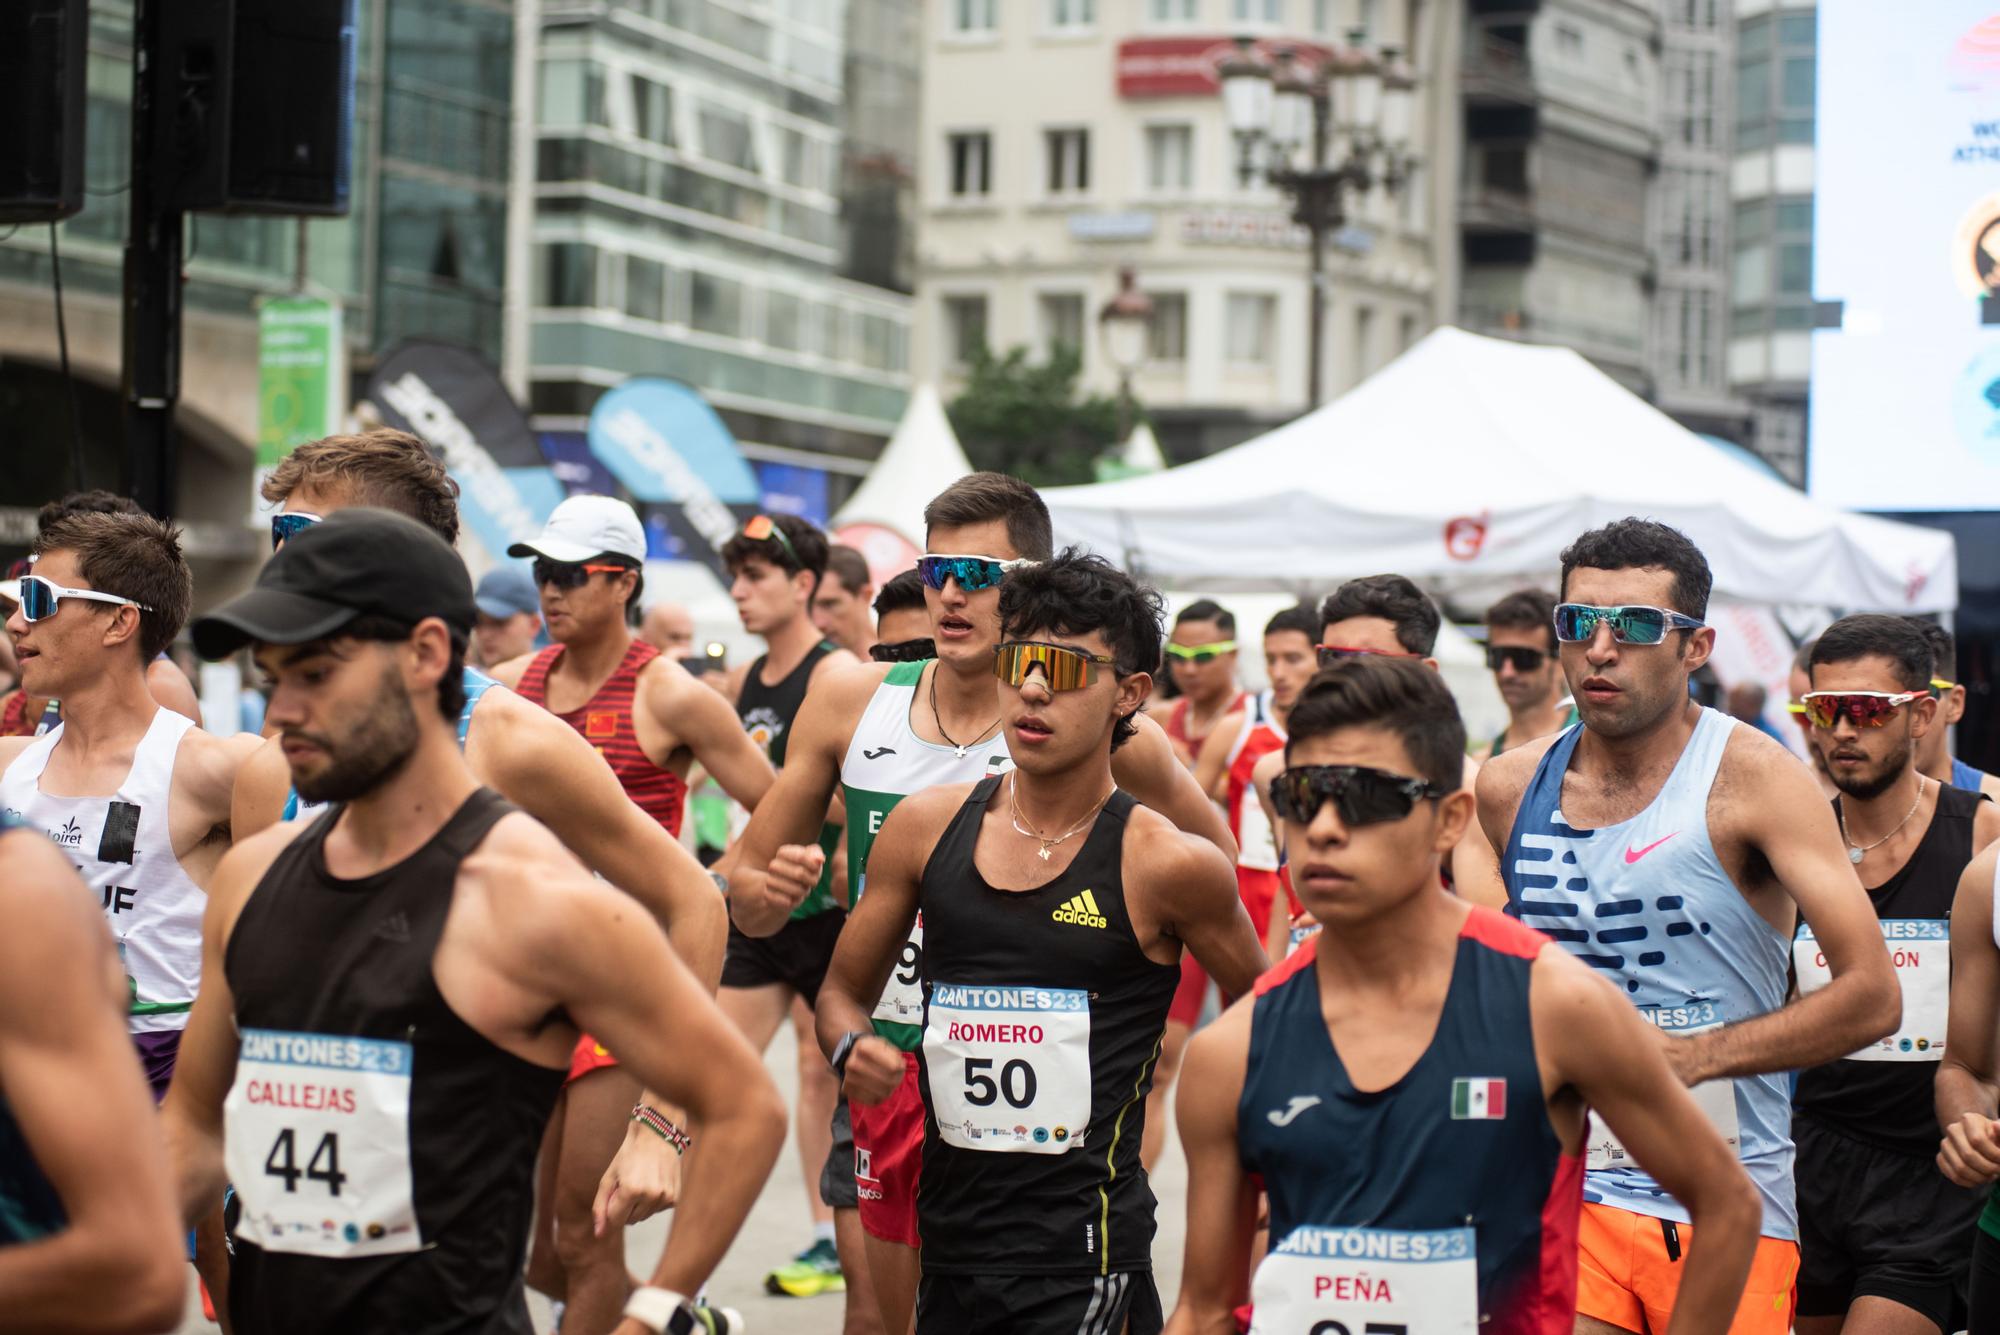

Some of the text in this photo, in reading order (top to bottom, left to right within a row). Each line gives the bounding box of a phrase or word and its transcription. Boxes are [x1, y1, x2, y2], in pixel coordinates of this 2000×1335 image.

[1052, 909, 1107, 929] adidas
[896, 941, 922, 986] 9
[937, 985, 1082, 1011] CANTONES23
[1640, 1002, 1715, 1027] NES23
[949, 1022, 1044, 1044] ROMERO
[247, 1080, 356, 1114] CALLEJAS
[964, 1057, 1038, 1109] 50
[265, 1128, 347, 1197] 44
[1315, 1271, 1393, 1303] PEÑA
